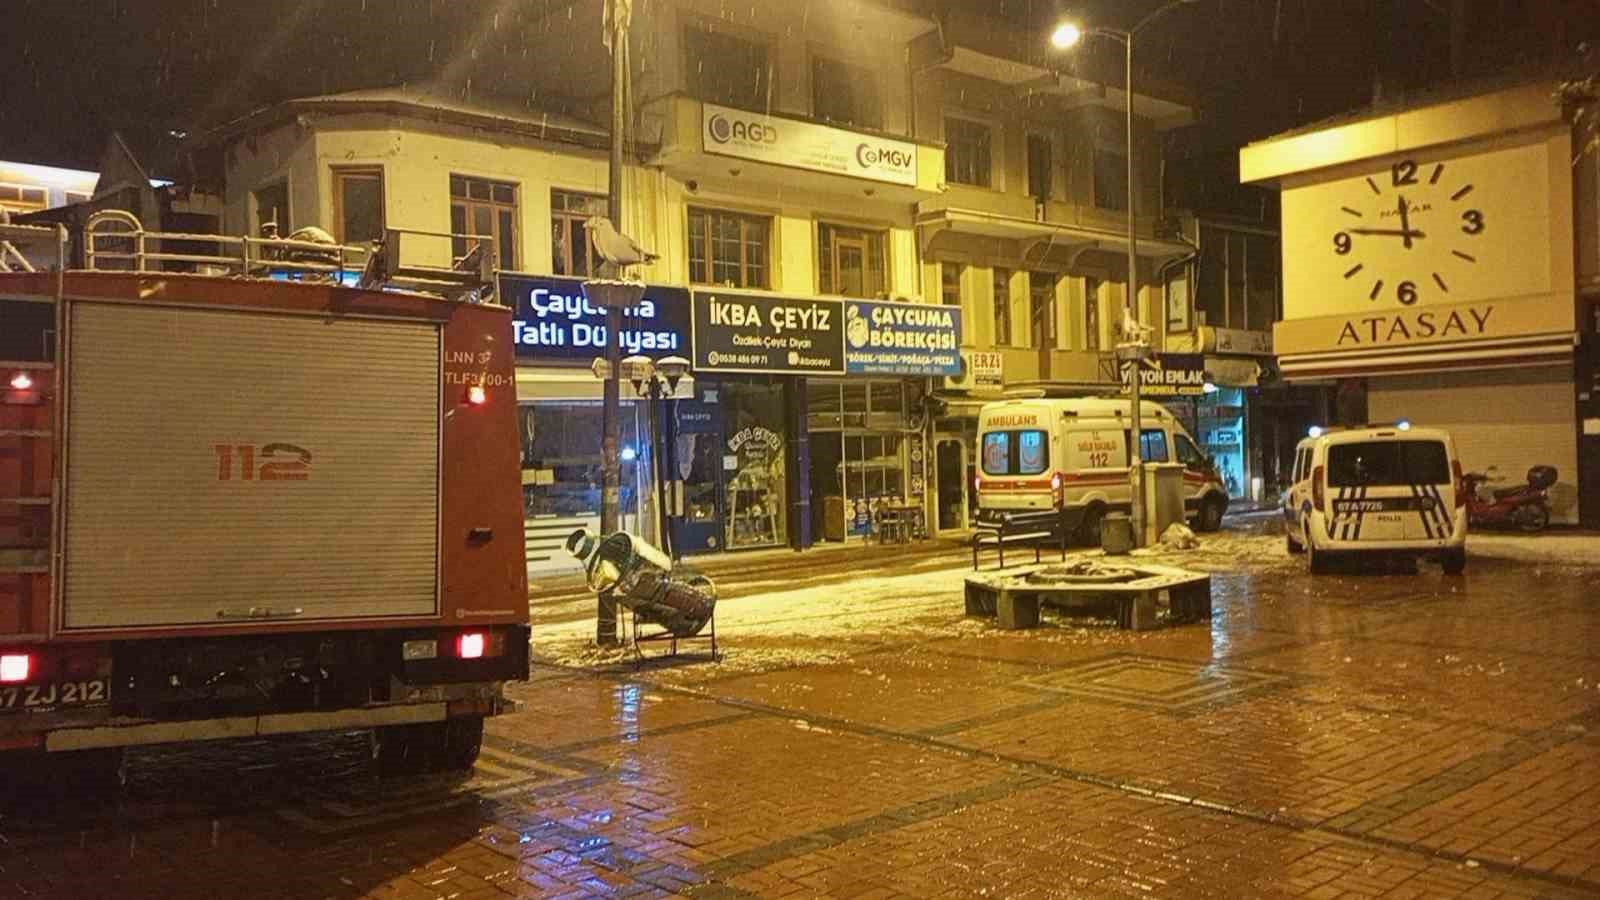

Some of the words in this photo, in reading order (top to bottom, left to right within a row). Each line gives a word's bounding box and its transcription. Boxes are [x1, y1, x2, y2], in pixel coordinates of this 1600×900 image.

[733, 120, 777, 143] AGD
[878, 147, 912, 168] MGV
[1392, 160, 1418, 187] 12
[1461, 209, 1485, 235] 3
[1333, 232, 1351, 255] 9
[1397, 281, 1418, 305] 6
[710, 296, 762, 327] İKBA
[770, 303, 830, 334] ÇEYİZ
[871, 307, 953, 328] ÇAYCUMA
[1337, 306, 1493, 345] ATASAY
[512, 320, 564, 346] Tatlı
[572, 323, 677, 354] Düyası
[870, 326, 956, 352] BÖREKÇİSİ
[445, 351, 474, 364] LNN
[445, 371, 513, 387] TLF300-1
[1166, 369, 1204, 384] EMLAK
[987, 416, 1037, 427] AMBULANS
[208, 440, 312, 480] 112
[1089, 452, 1108, 468] 112
[24, 684, 57, 705] ZJ
[62, 680, 104, 702] 212
